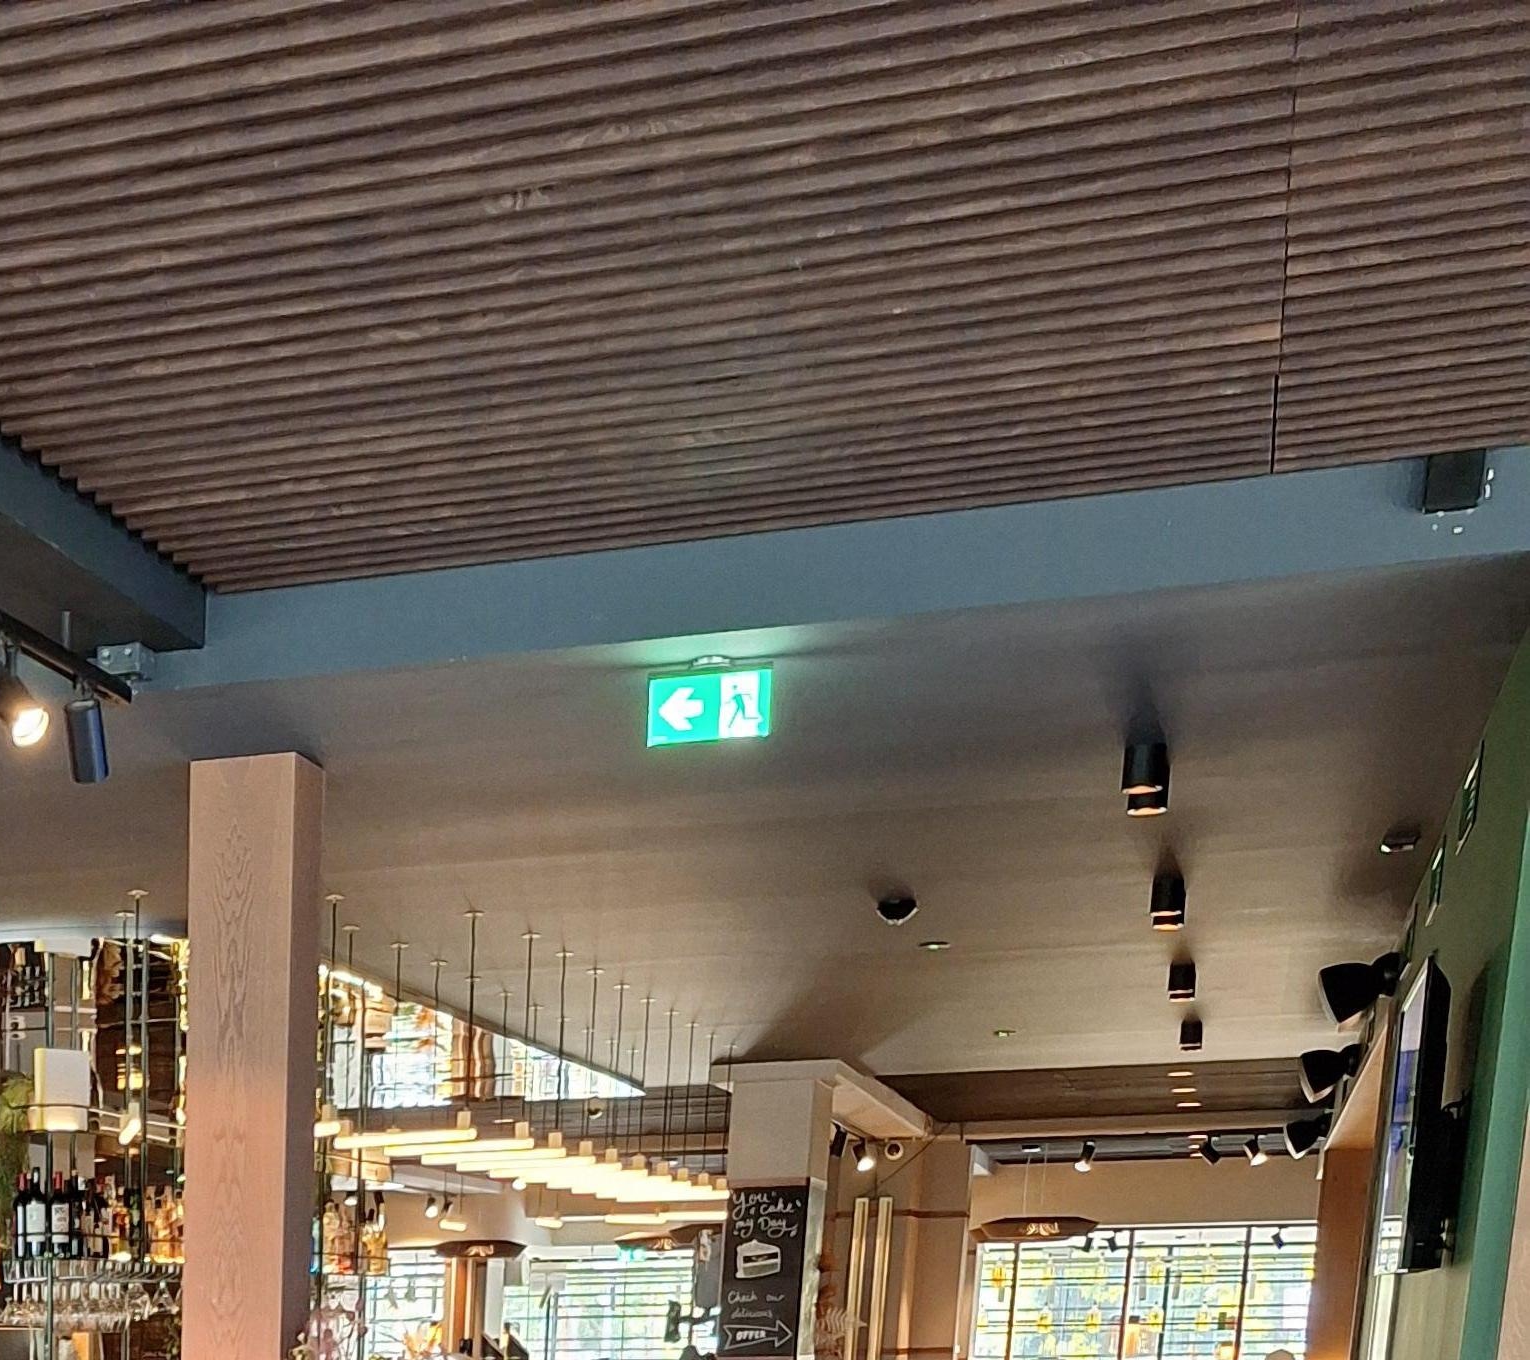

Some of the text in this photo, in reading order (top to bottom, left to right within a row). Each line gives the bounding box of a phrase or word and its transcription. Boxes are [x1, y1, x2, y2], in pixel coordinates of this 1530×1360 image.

[731, 1190, 771, 1221] You
[759, 1197, 795, 1216] cake
[734, 1215, 799, 1239] my Day
[735, 1329, 767, 1342] OFFER
